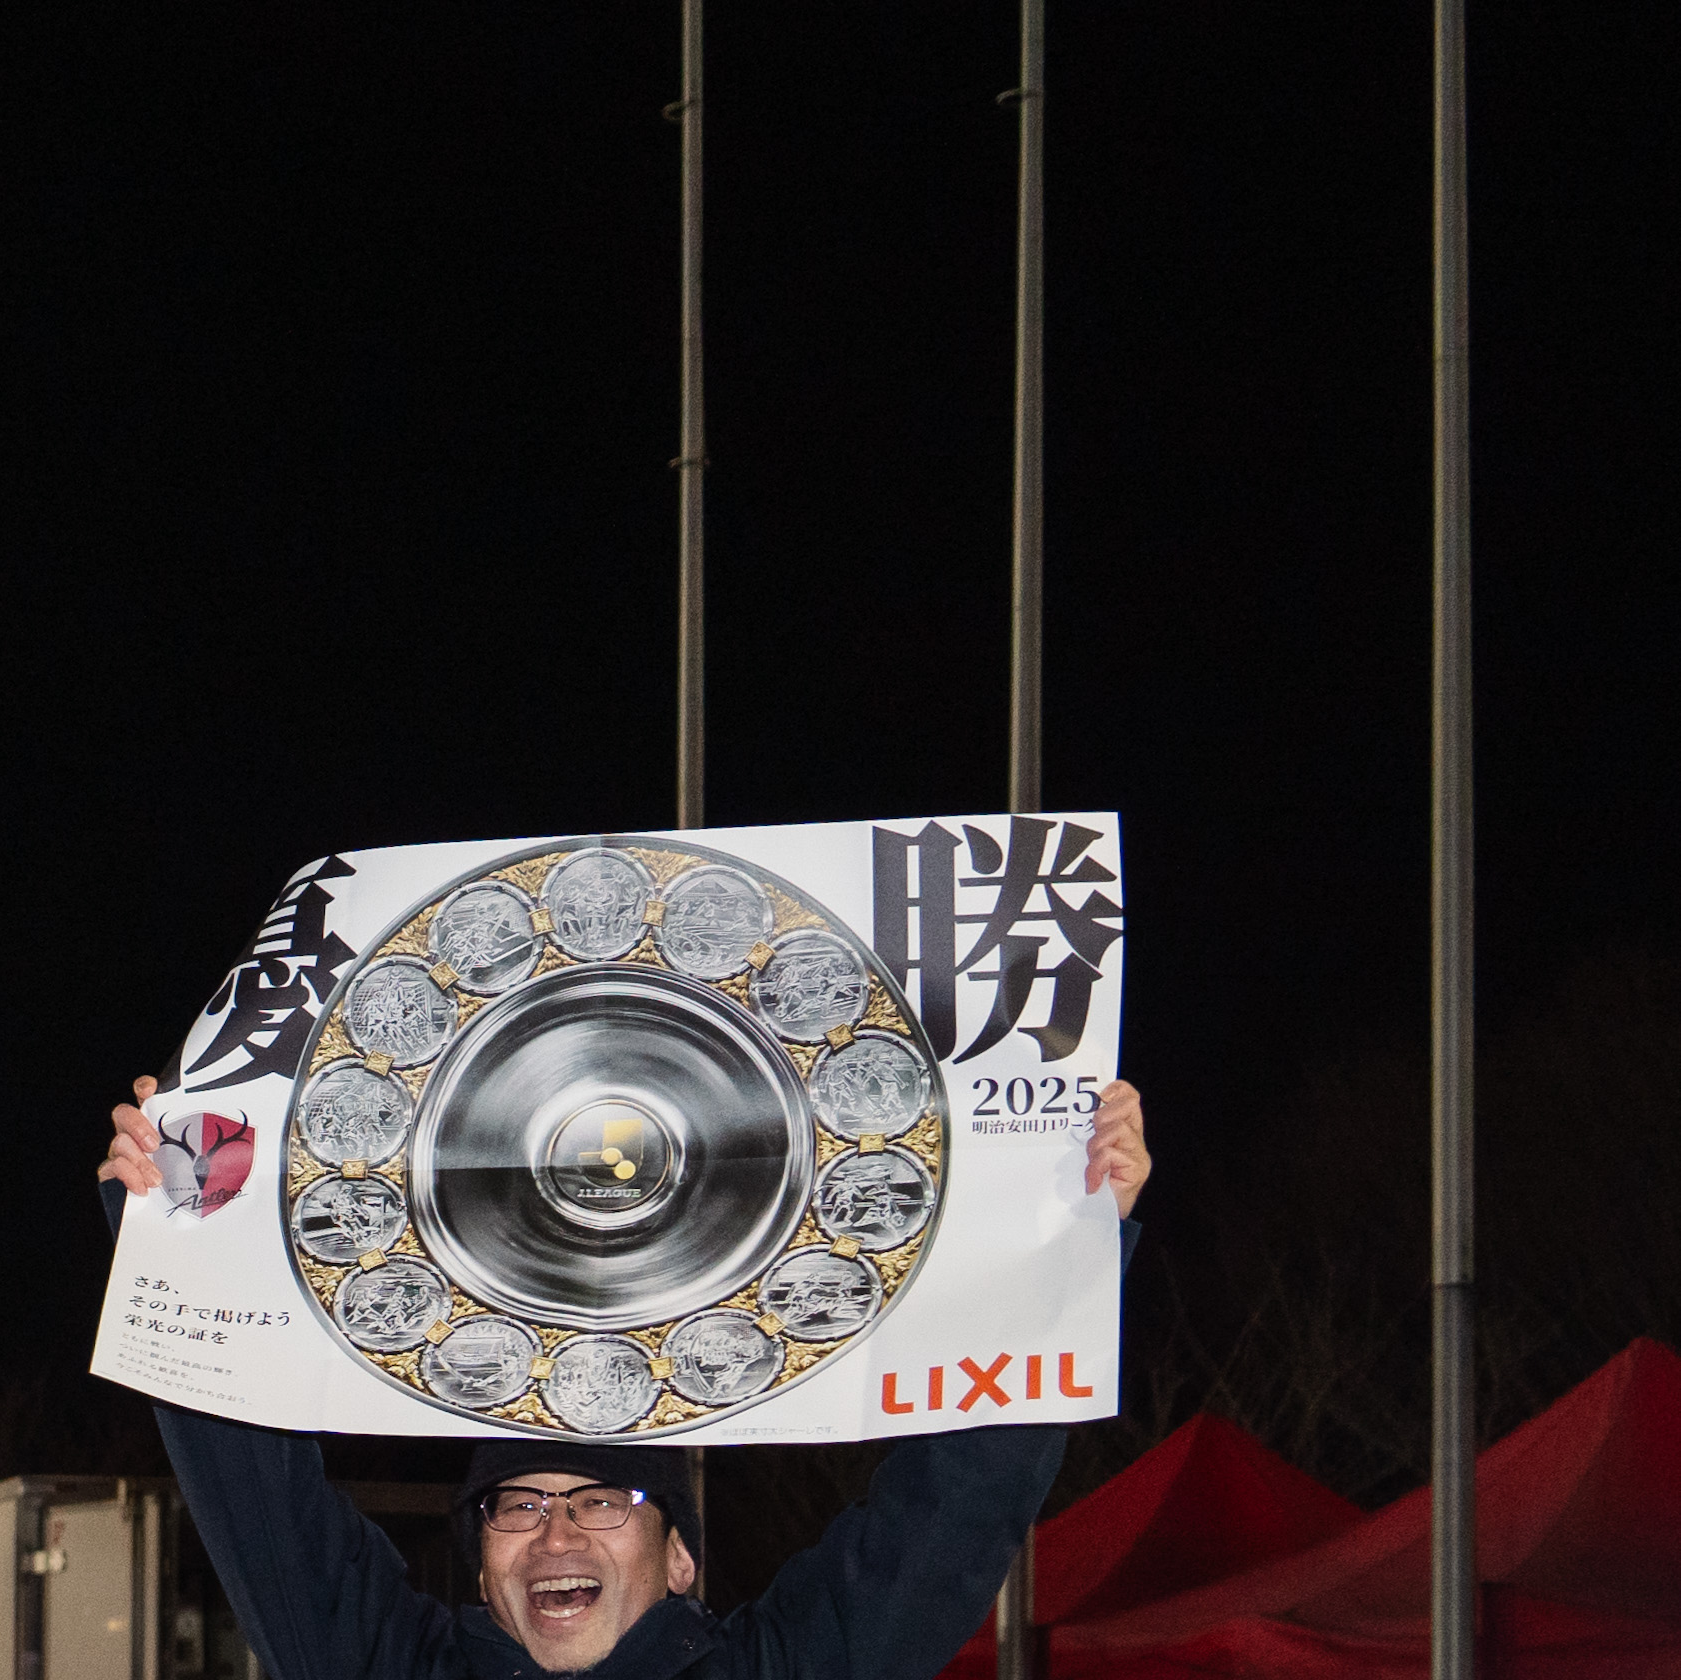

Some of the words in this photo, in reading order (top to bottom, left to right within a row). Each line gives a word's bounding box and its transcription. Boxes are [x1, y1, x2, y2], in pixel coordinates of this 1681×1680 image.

[872, 815, 1124, 1065] 勝
[971, 1076, 1101, 1117] 2025
[134, 1275, 181, 1296] さあ、
[123, 1312, 229, 1346] 栄光の証を
[128, 1295, 292, 1327] その手で掲げよう
[880, 1351, 1094, 1415] LIXIL
